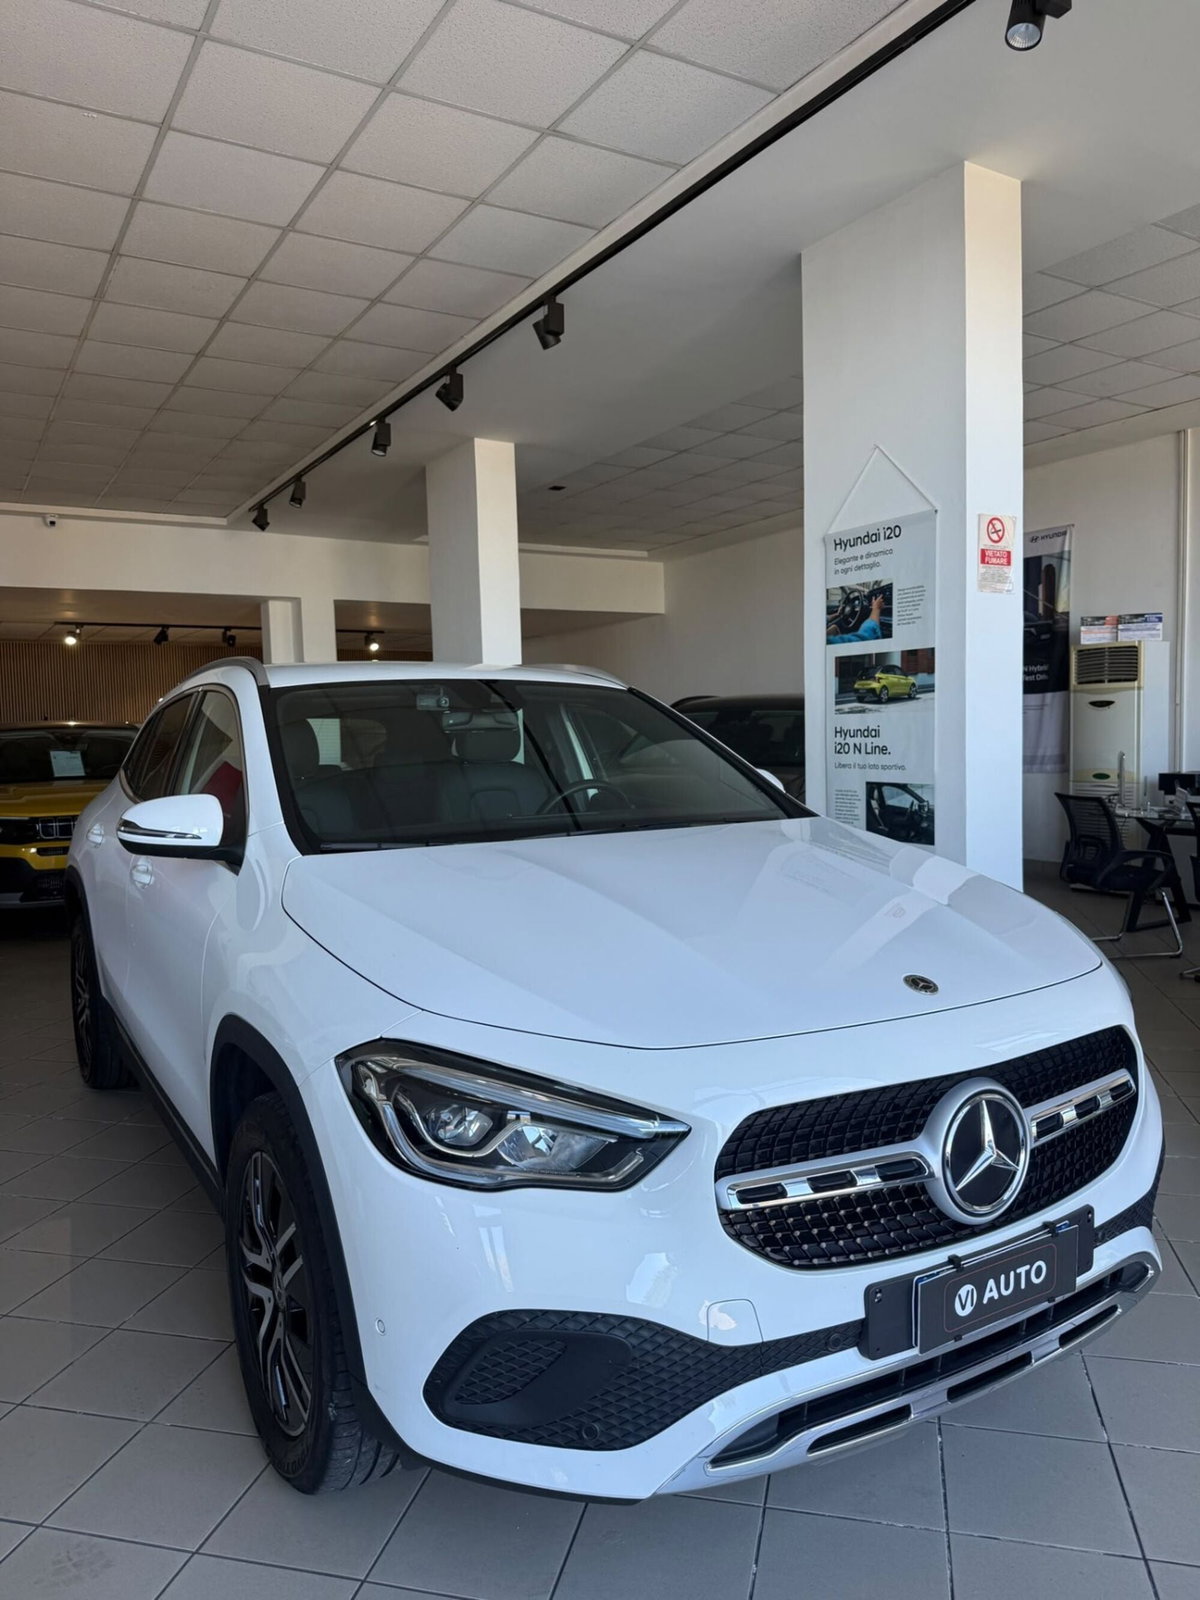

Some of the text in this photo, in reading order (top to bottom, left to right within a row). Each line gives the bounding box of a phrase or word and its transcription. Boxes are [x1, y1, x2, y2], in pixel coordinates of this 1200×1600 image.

[834, 525, 901, 552] Hyundai i20
[834, 554, 858, 565] Elegante
[985, 550, 1007, 558] VIETATO
[985, 557, 1008, 565] FUMARE
[840, 565, 853, 575] ogni
[834, 725, 880, 740] Hyundai
[834, 742, 891, 755] i20 N Line.
[983, 1260, 1047, 1304] AUTO
